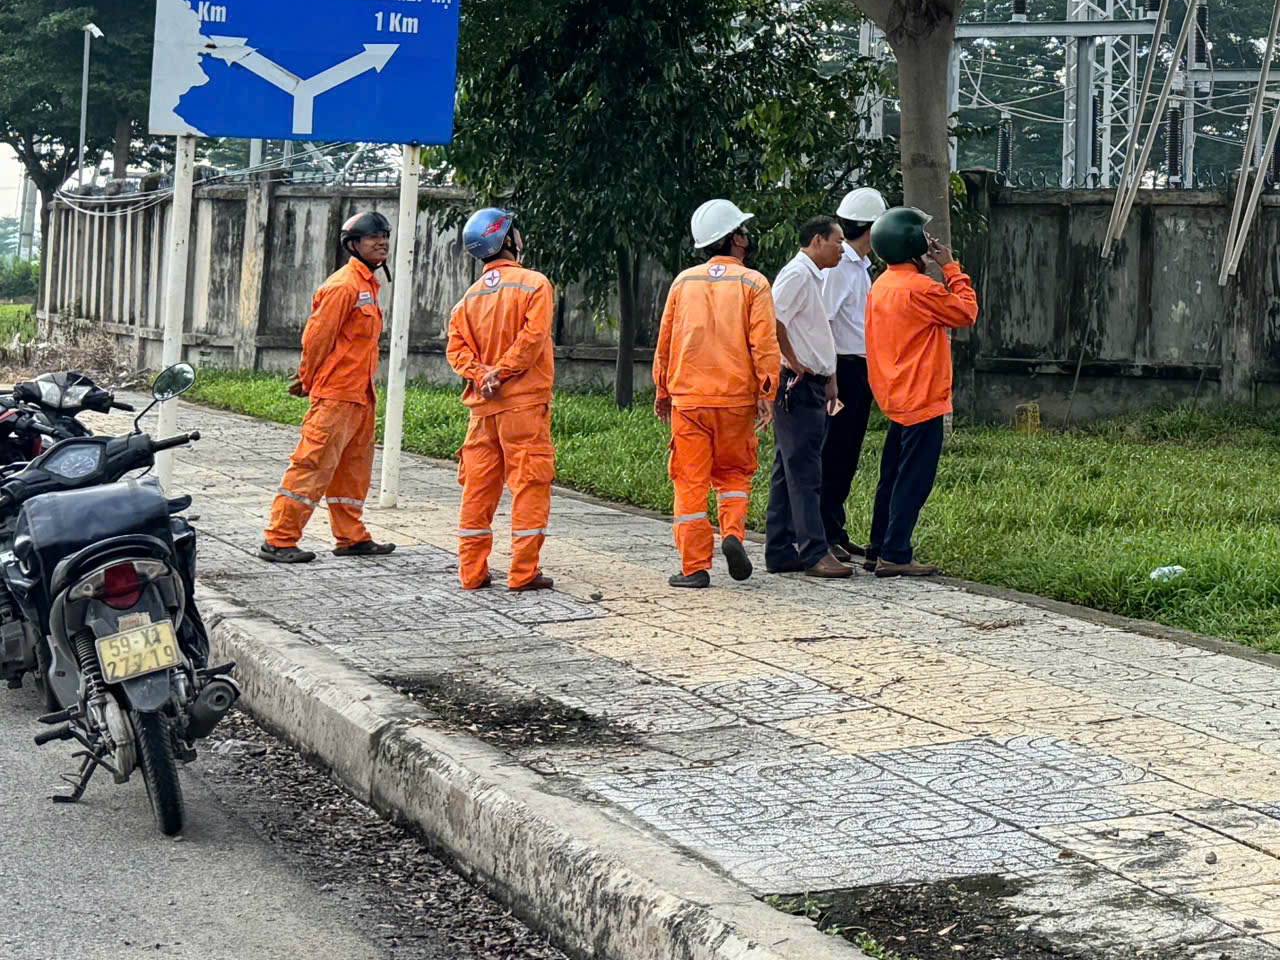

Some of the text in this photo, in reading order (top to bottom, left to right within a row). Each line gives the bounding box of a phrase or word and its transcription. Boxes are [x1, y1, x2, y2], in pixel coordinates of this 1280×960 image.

[198, 0, 227, 23] Km
[375, 11, 419, 34] 1 Km
